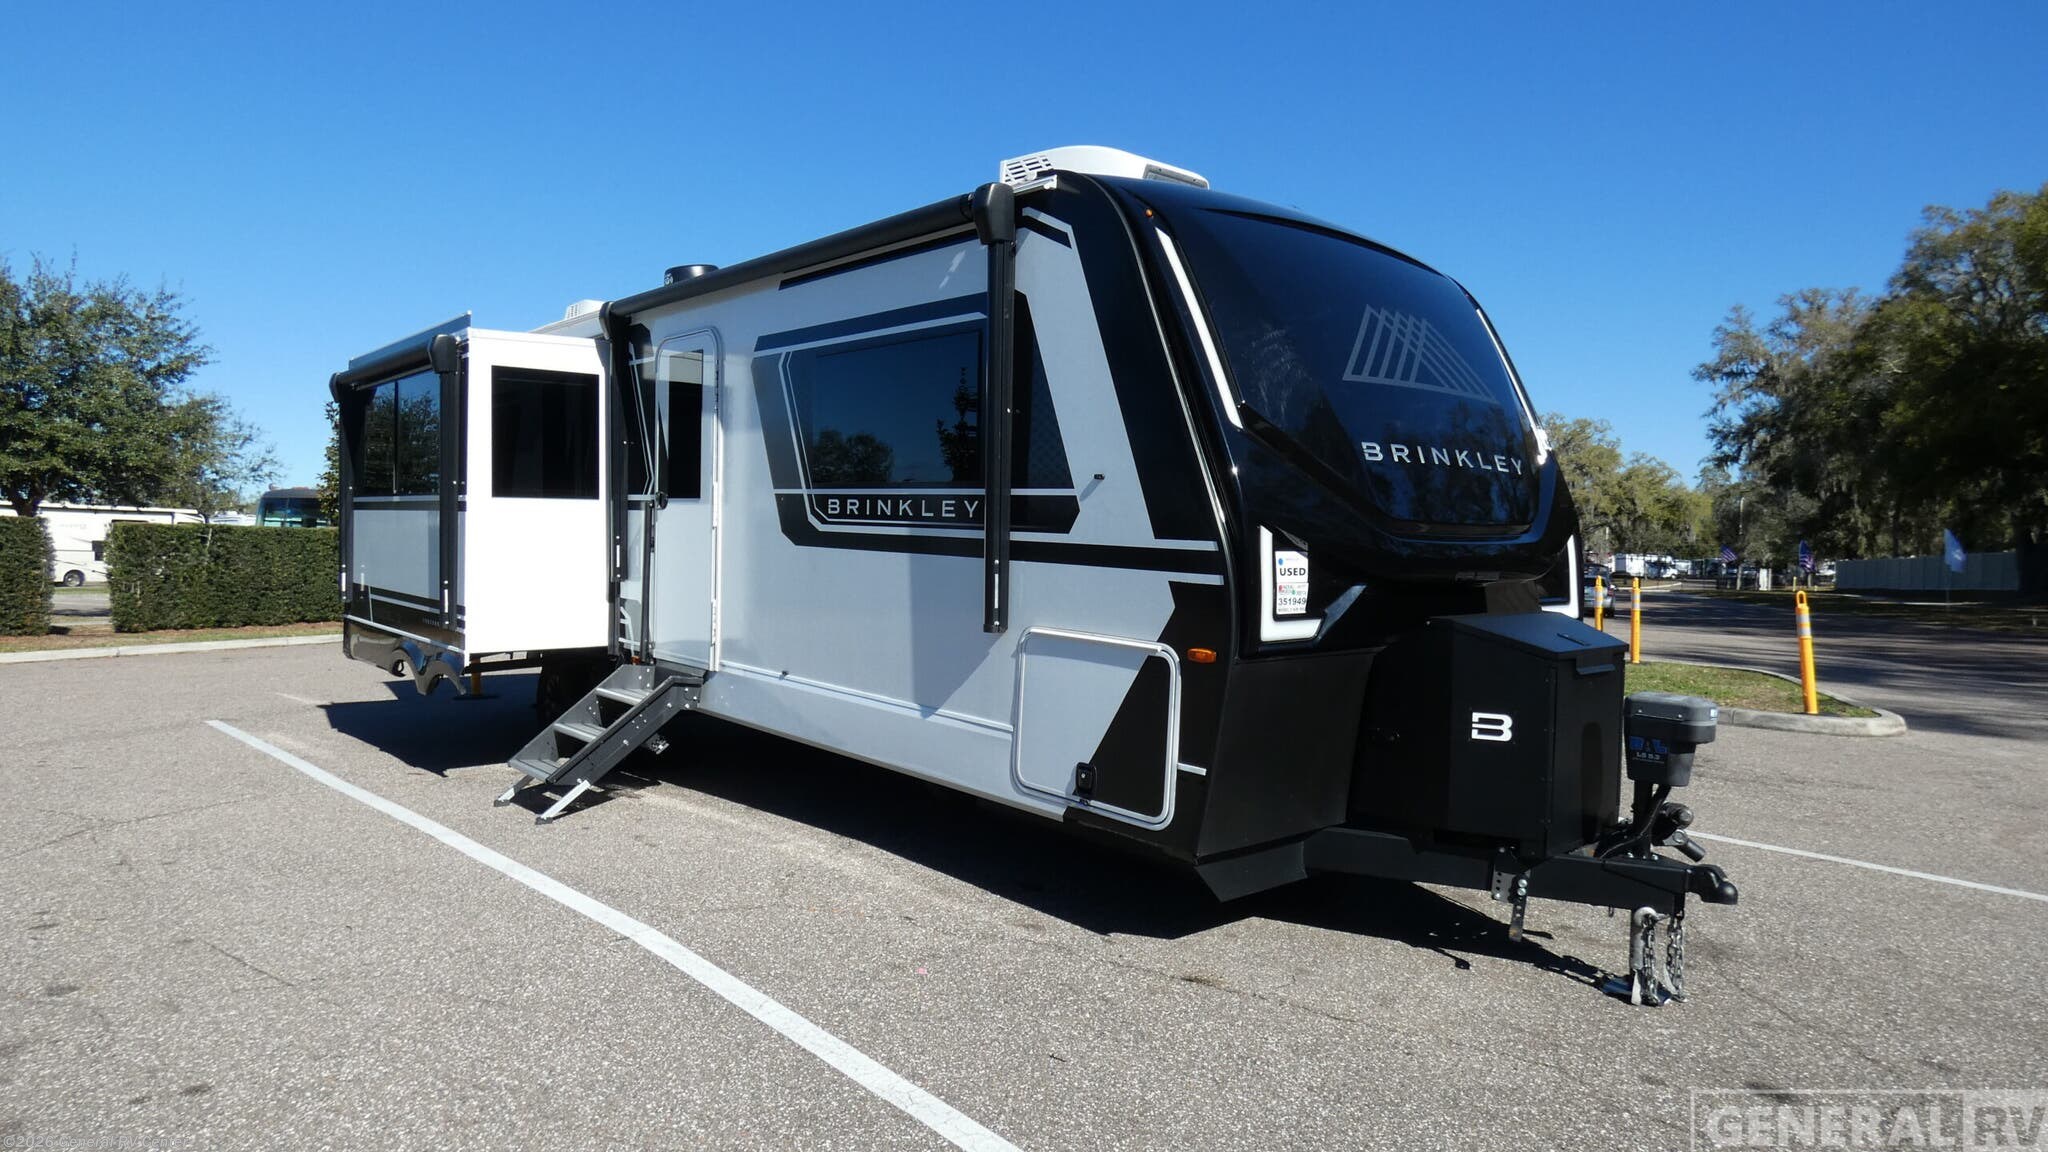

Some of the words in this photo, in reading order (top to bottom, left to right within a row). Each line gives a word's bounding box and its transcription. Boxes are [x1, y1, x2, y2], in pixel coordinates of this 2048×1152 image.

[1361, 441, 1522, 475] BRINKLEY
[827, 498, 979, 518] BRINKLEY
[1279, 567, 1306, 577] USED
[1278, 597, 1306, 606] 351949
